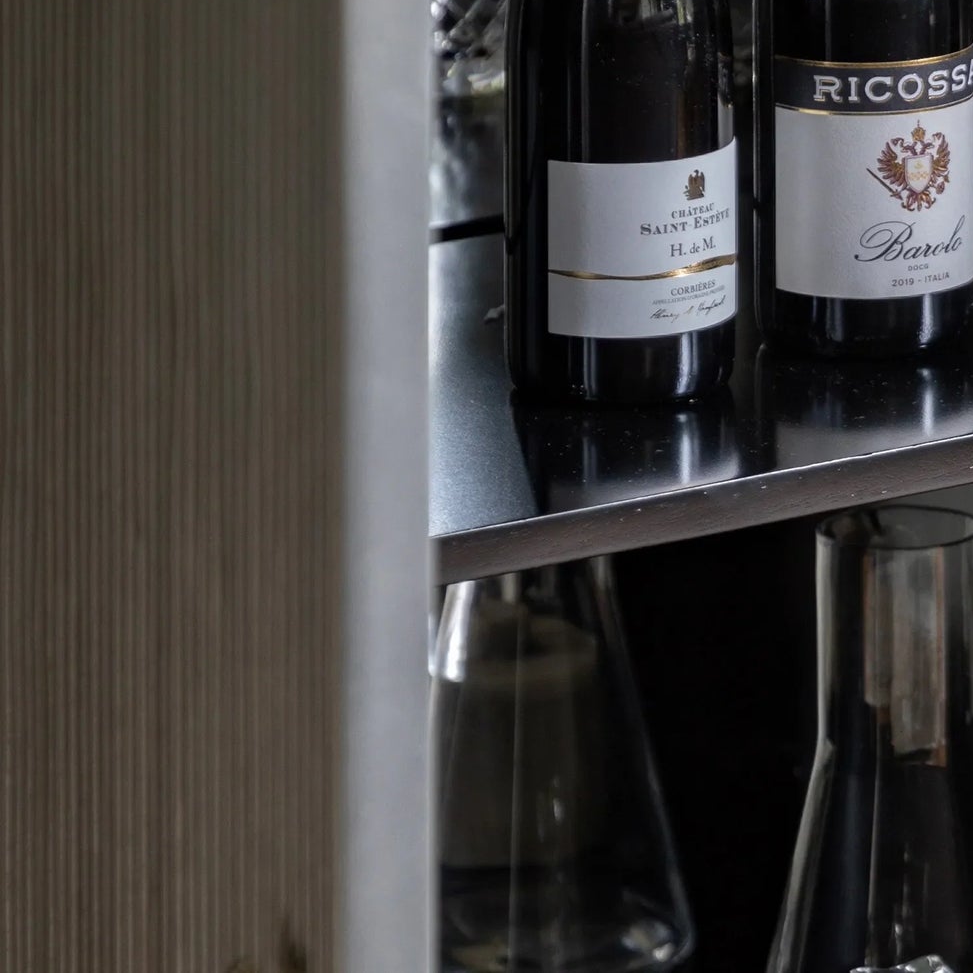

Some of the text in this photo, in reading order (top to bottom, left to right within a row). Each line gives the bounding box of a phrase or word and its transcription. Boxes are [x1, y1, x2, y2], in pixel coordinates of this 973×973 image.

[670, 203, 716, 220] CHÂTEAU
[670, 236, 716, 258] H. de M.
[854, 214, 966, 263] Barolo
[907, 263, 930, 273] DOCG
[670, 279, 717, 297] CORBIÈRES
[891, 276, 915, 287] 2019
[924, 272, 950, 284] ITALIA
